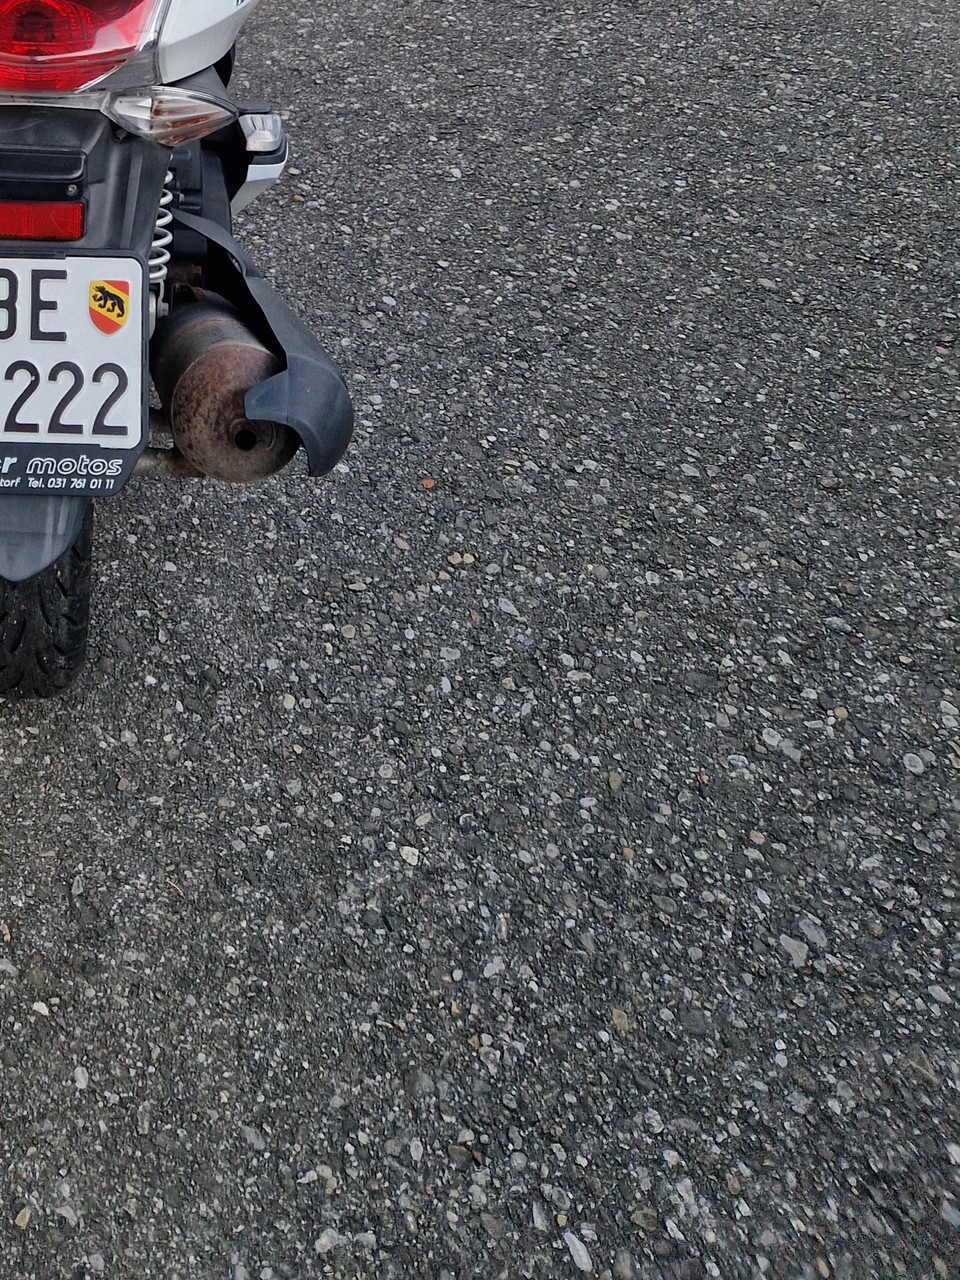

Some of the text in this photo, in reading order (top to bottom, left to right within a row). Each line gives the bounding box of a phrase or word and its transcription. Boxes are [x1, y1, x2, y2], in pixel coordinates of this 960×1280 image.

[26, 454, 123, 476] motos
[27, 477, 45, 488] Tel.
[47, 477, 67, 488] 031
[70, 478, 87, 489] 761
[89, 478, 103, 489] 01
[105, 478, 115, 489] 11
